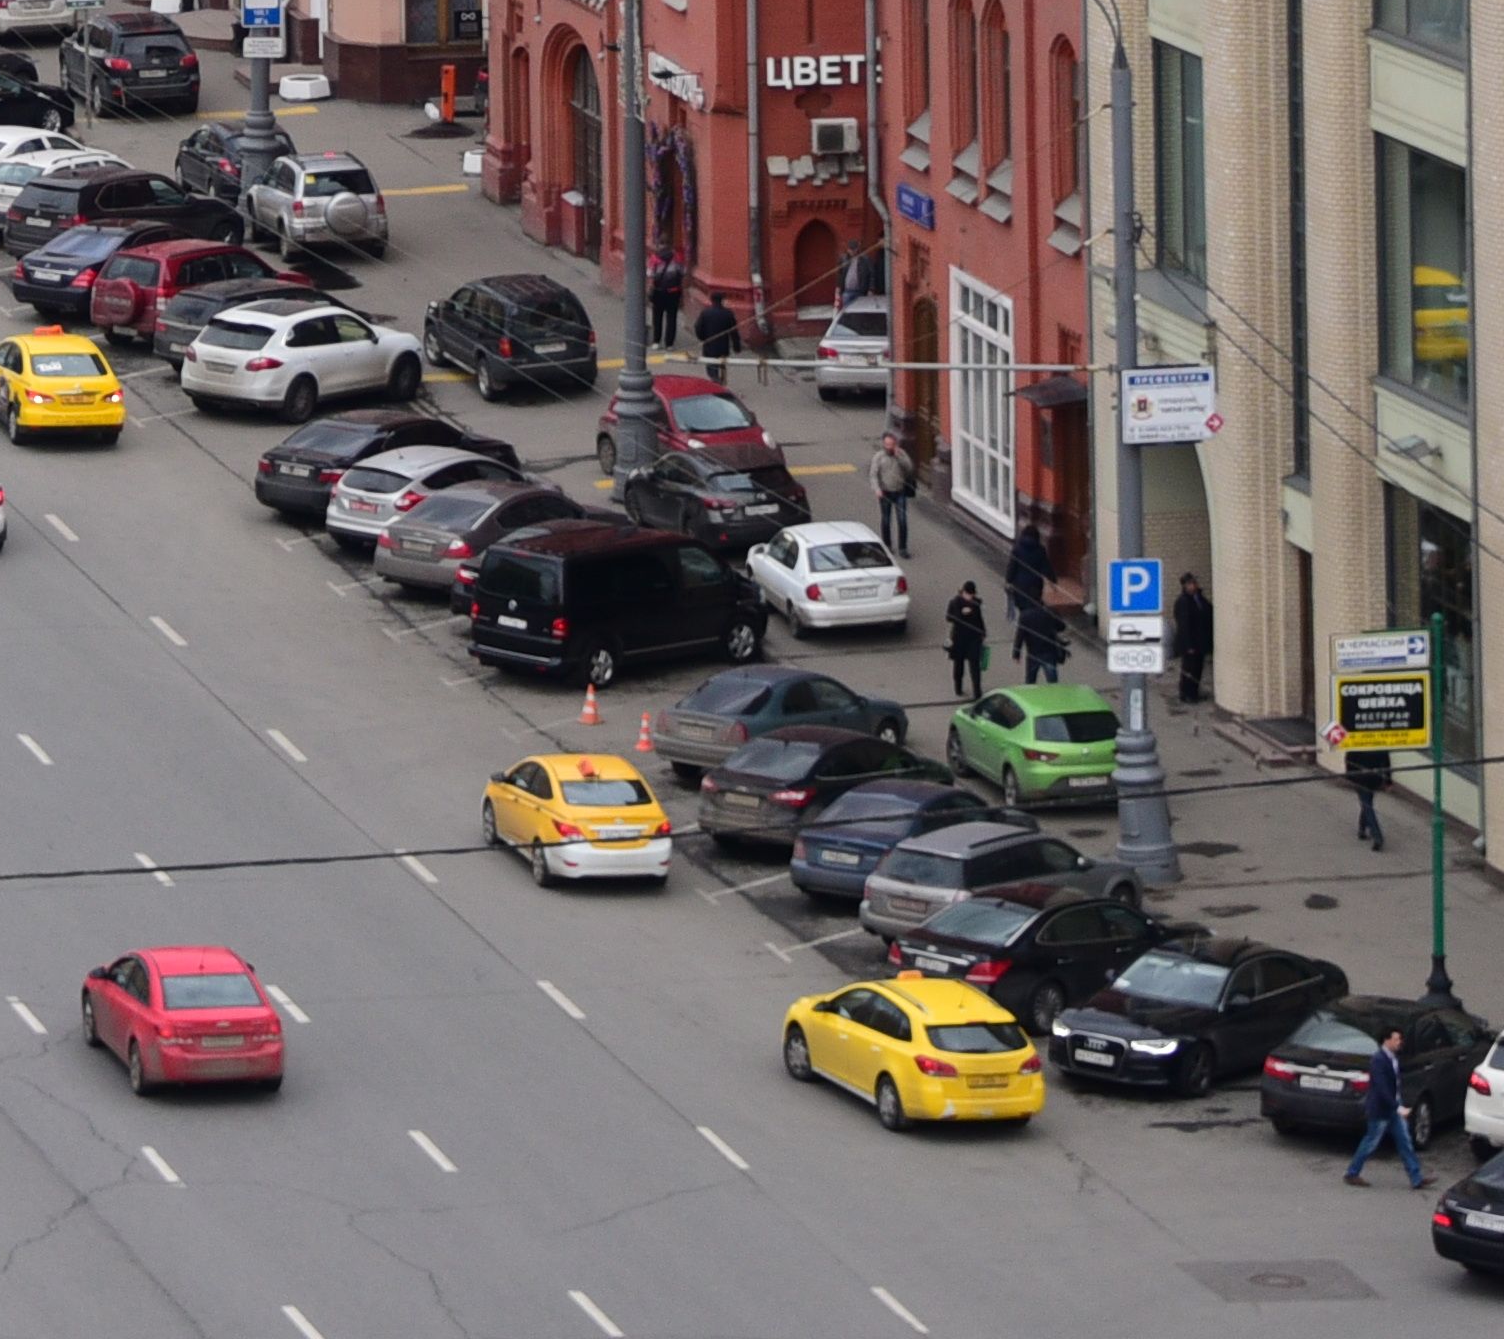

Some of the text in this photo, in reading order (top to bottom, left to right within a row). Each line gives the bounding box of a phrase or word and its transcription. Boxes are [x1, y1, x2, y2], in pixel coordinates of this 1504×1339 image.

[1122, 566, 1151, 607] P
[1340, 683, 1423, 697] СОКРОВИЩА
[1357, 696, 1407, 709] ШЕЙХА
[1354, 711, 1411, 720] РЕСТОРАН
